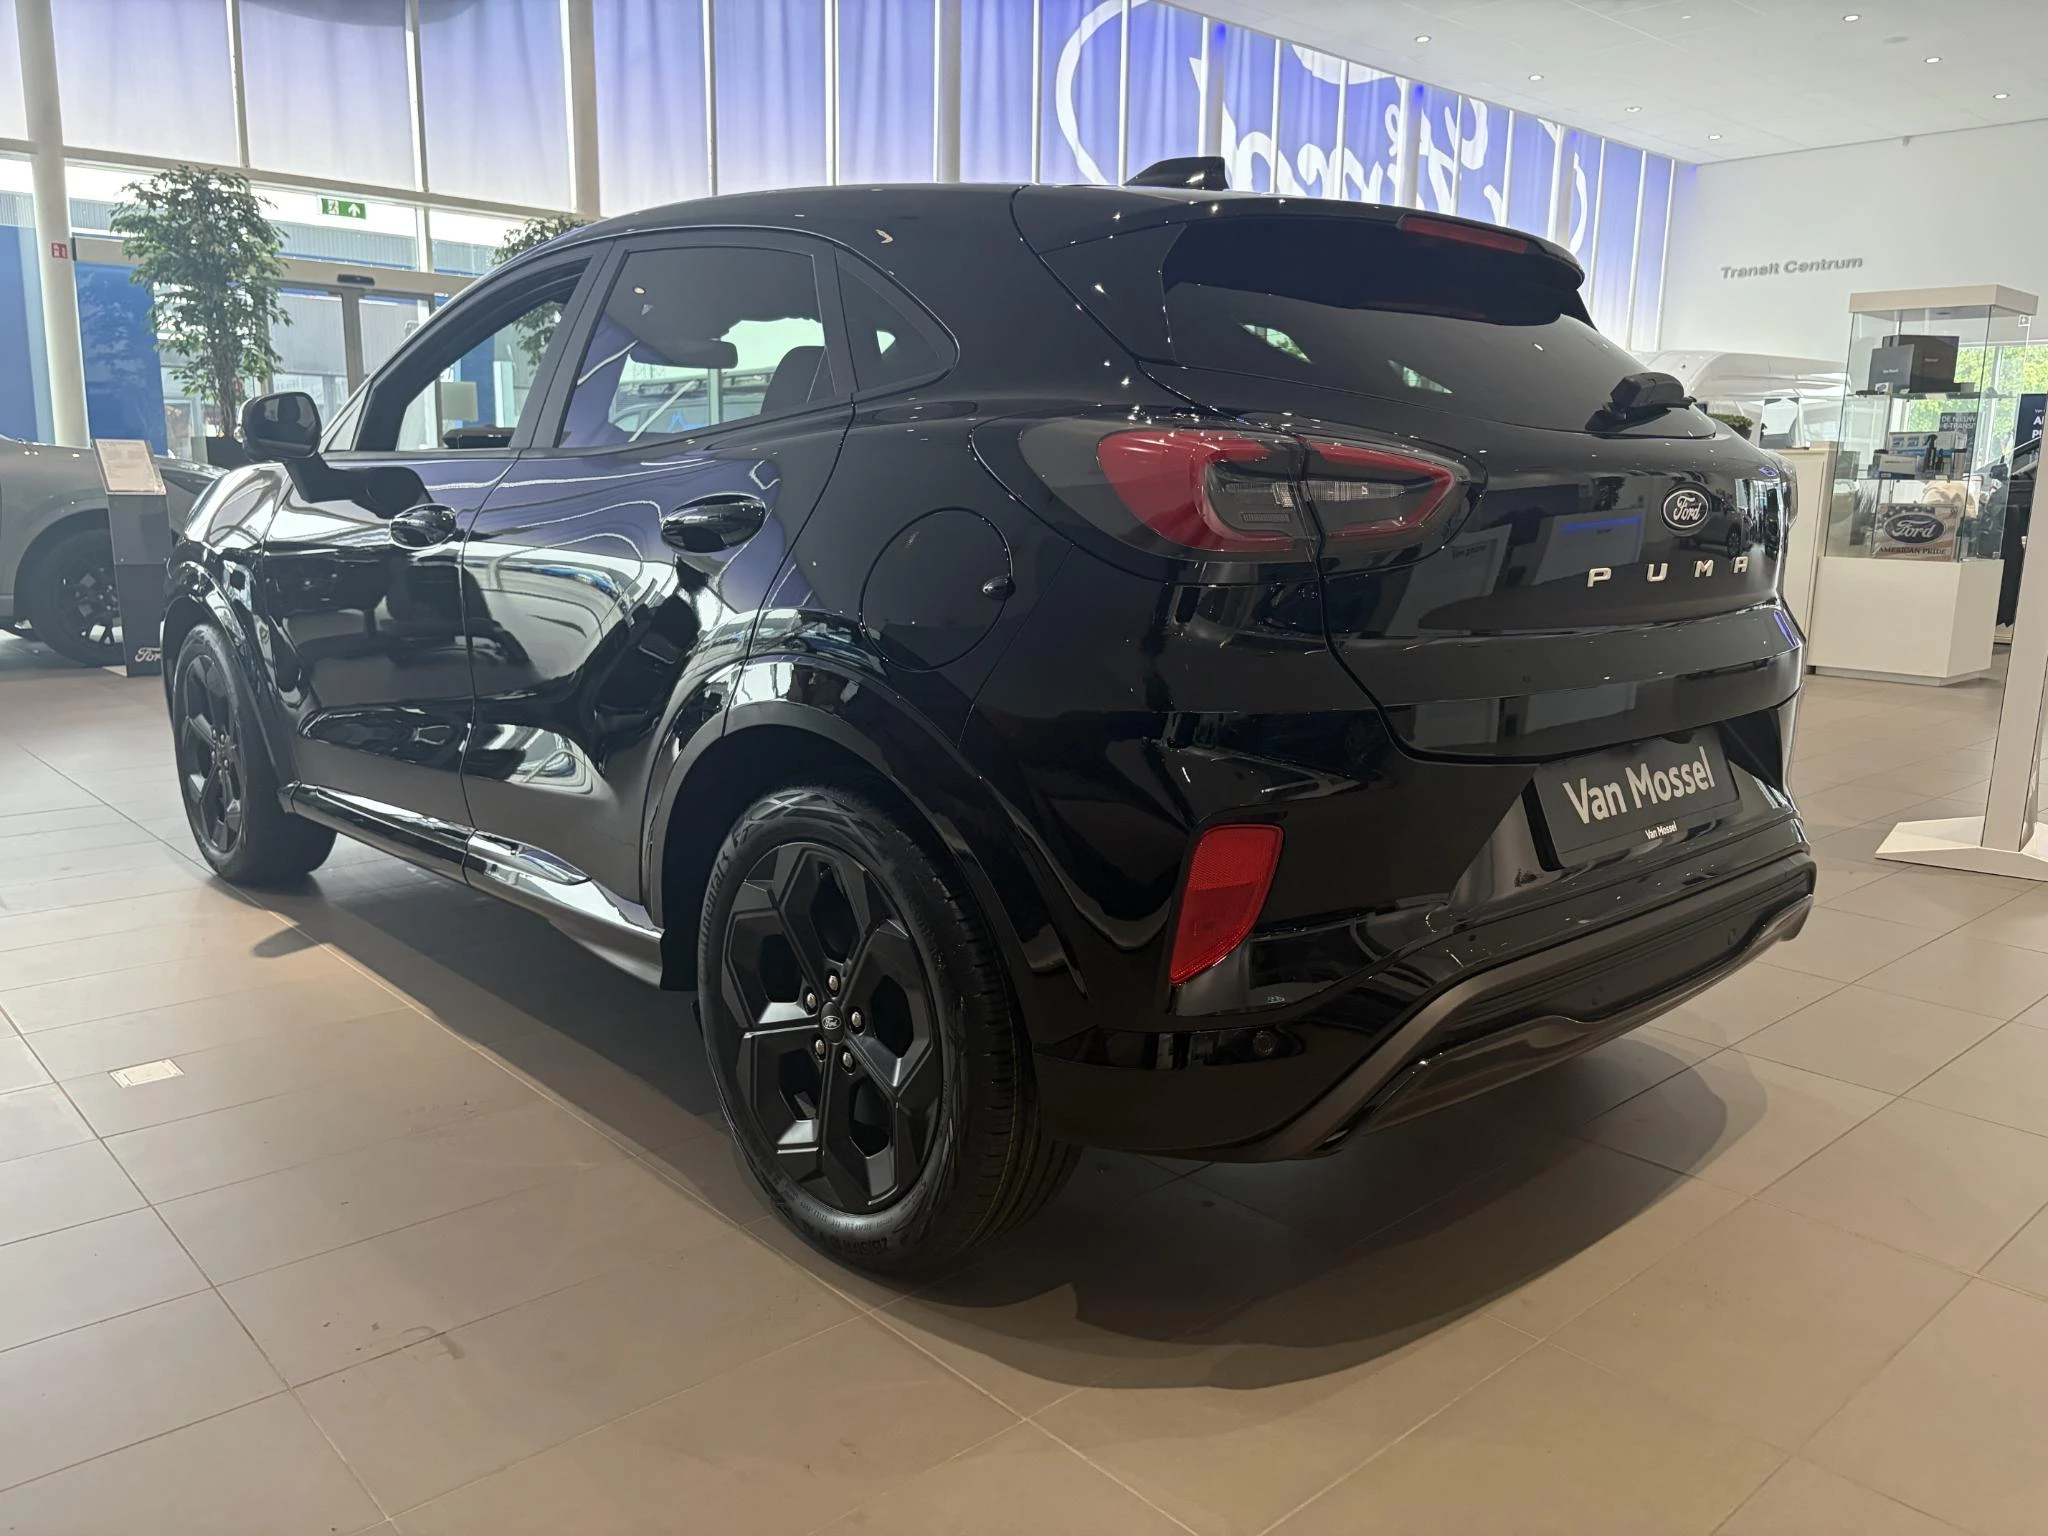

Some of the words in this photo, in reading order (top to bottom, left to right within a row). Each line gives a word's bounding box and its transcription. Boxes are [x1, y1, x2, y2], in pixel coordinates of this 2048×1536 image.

[1720, 262, 1780, 280] Transit
[1783, 256, 1864, 275] Centrum
[1673, 495, 1702, 521] Ford
[1891, 519, 1937, 538] Ford
[1879, 546, 1922, 555] AMERICAN
[1922, 547, 1946, 555] PRIDE
[1586, 555, 1750, 588] PUMA
[134, 646, 161, 663] For
[1562, 777, 1628, 825] Van
[1624, 746, 1716, 810] Mossel
[1644, 828, 1658, 840] Van
[1656, 820, 1678, 837] Mossel
